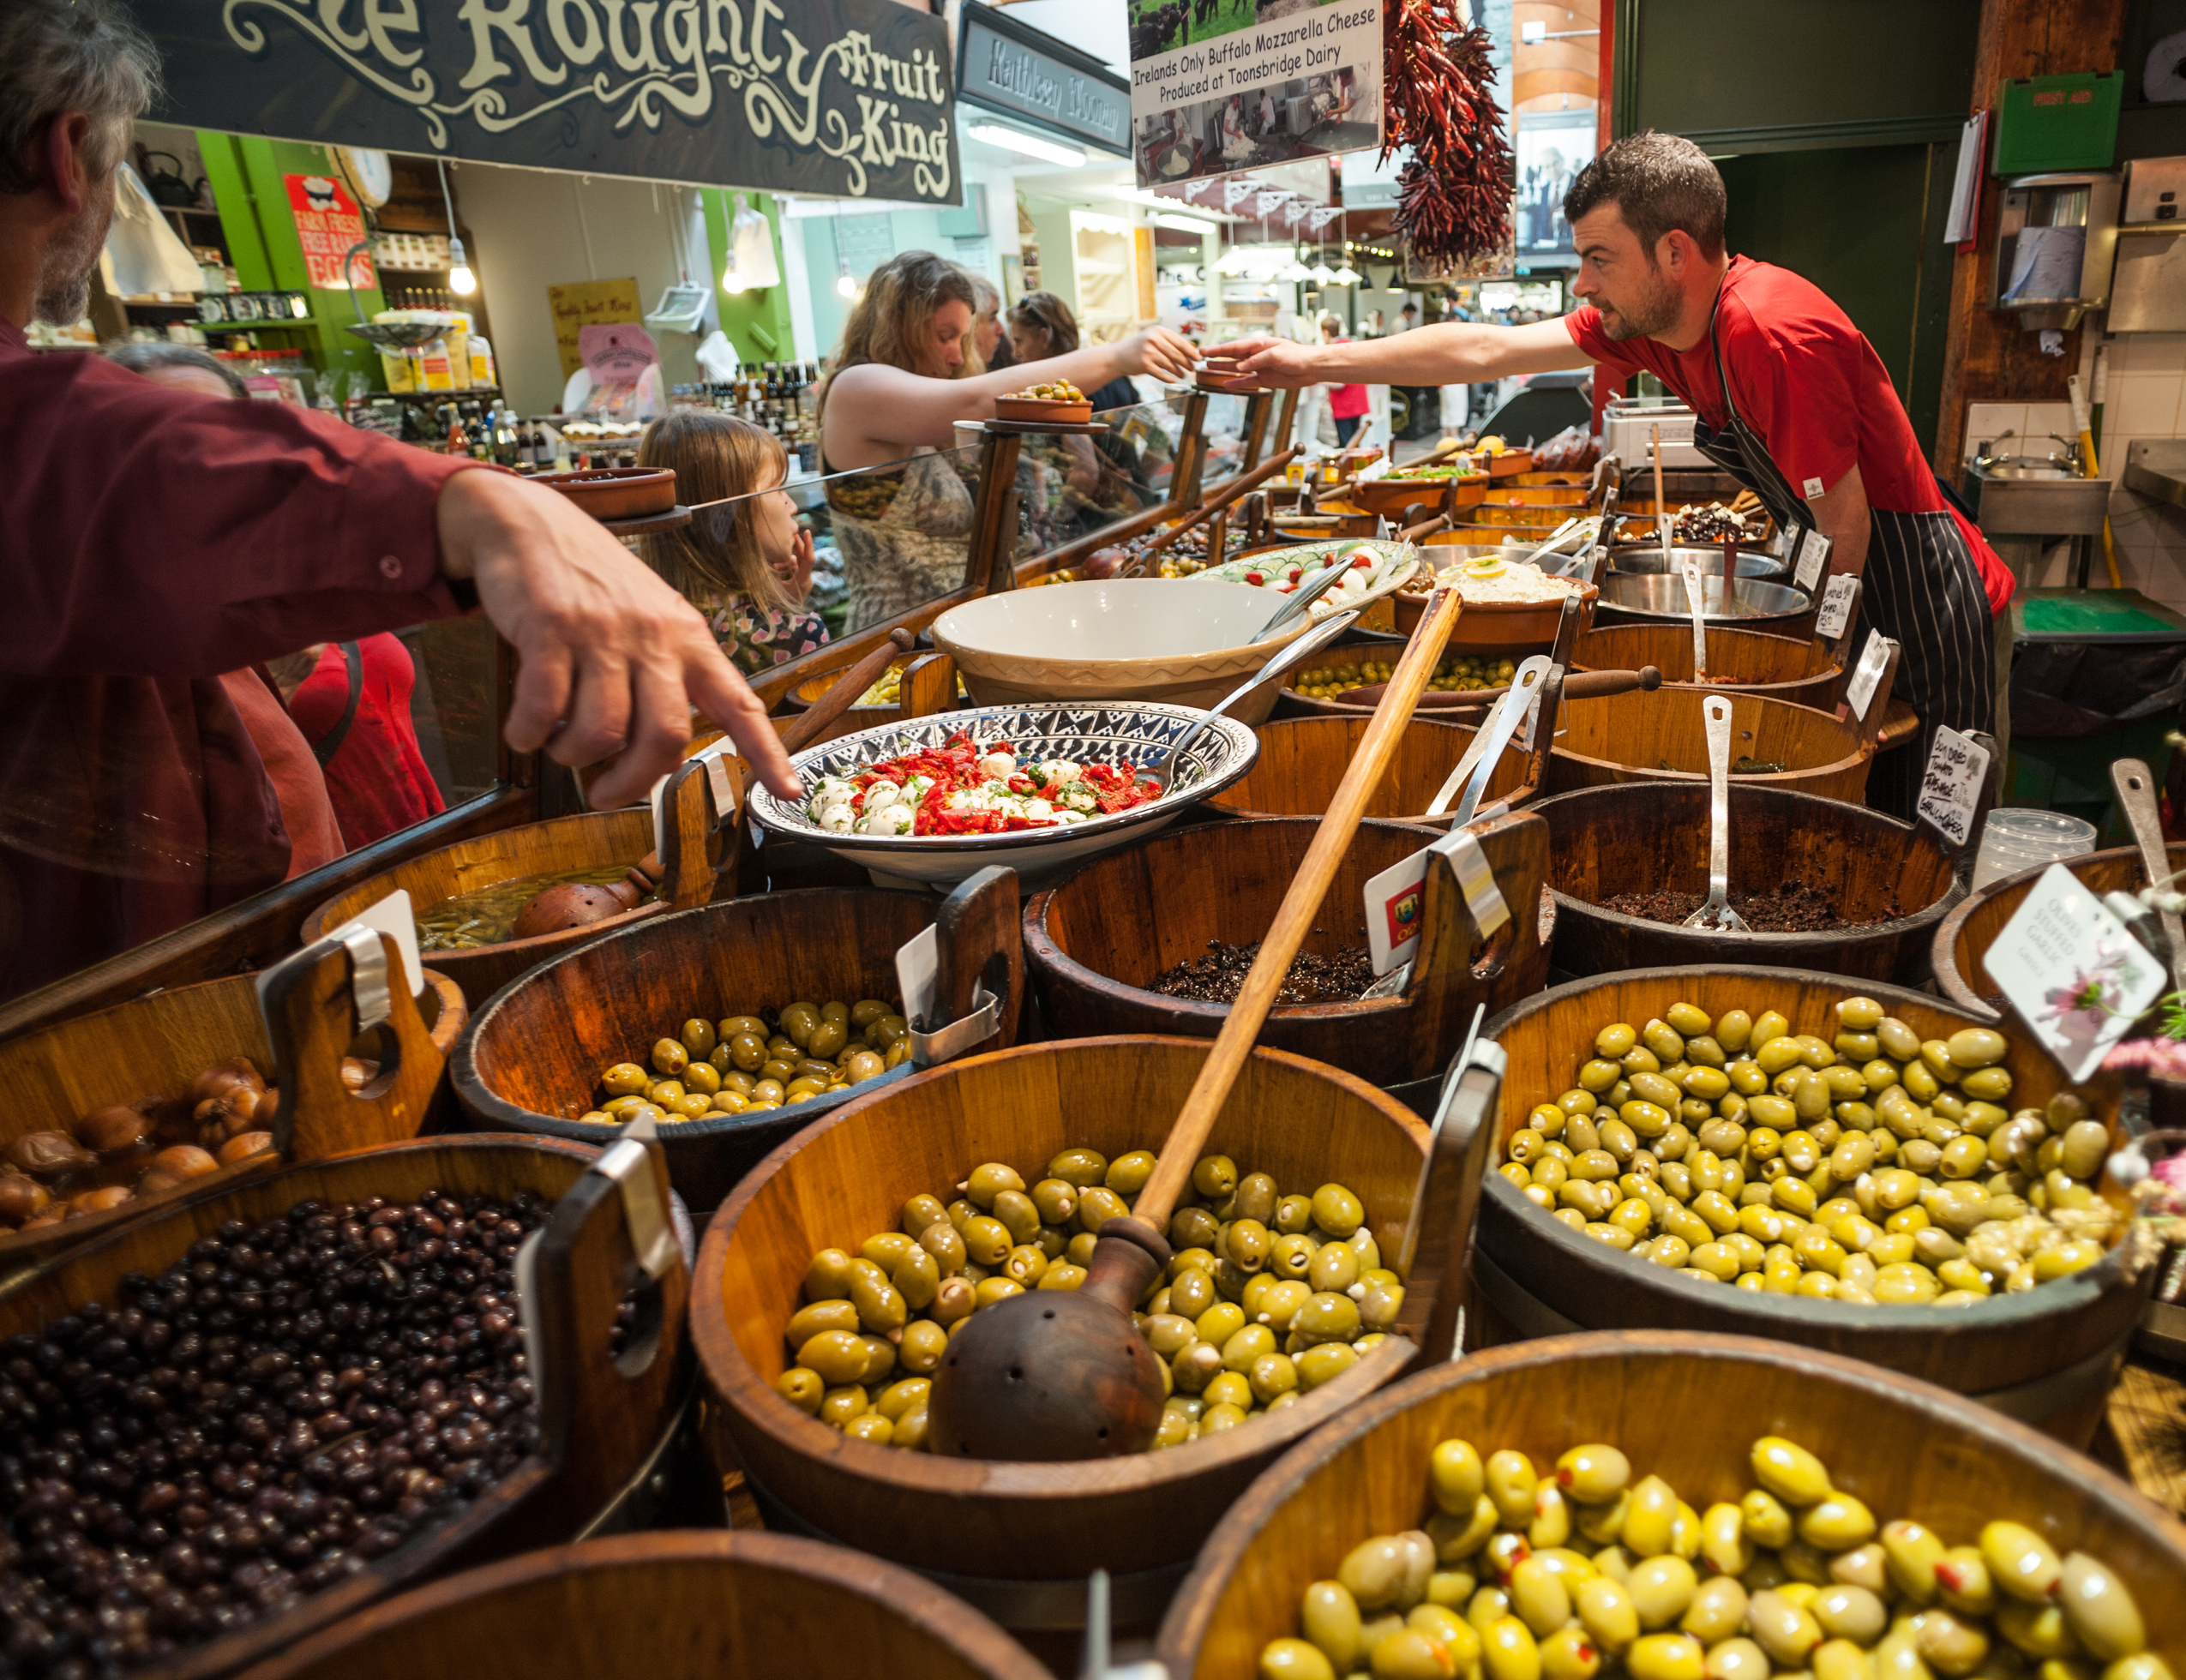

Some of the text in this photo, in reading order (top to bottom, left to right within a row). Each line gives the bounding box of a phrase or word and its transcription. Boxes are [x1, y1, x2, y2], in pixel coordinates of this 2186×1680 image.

[845, 30, 945, 105] Fruit
[1134, 8, 1376, 87] Irelands Only Buffalo Mozzarella Cheese
[1160, 44, 1341, 103] Produced at Toonsbridge Dairy
[2033, 90, 2092, 105] FIRST AID
[857, 94, 952, 198] King
[2026, 924, 2064, 969] GARLIC
[2033, 908, 2076, 956] STUFFED
